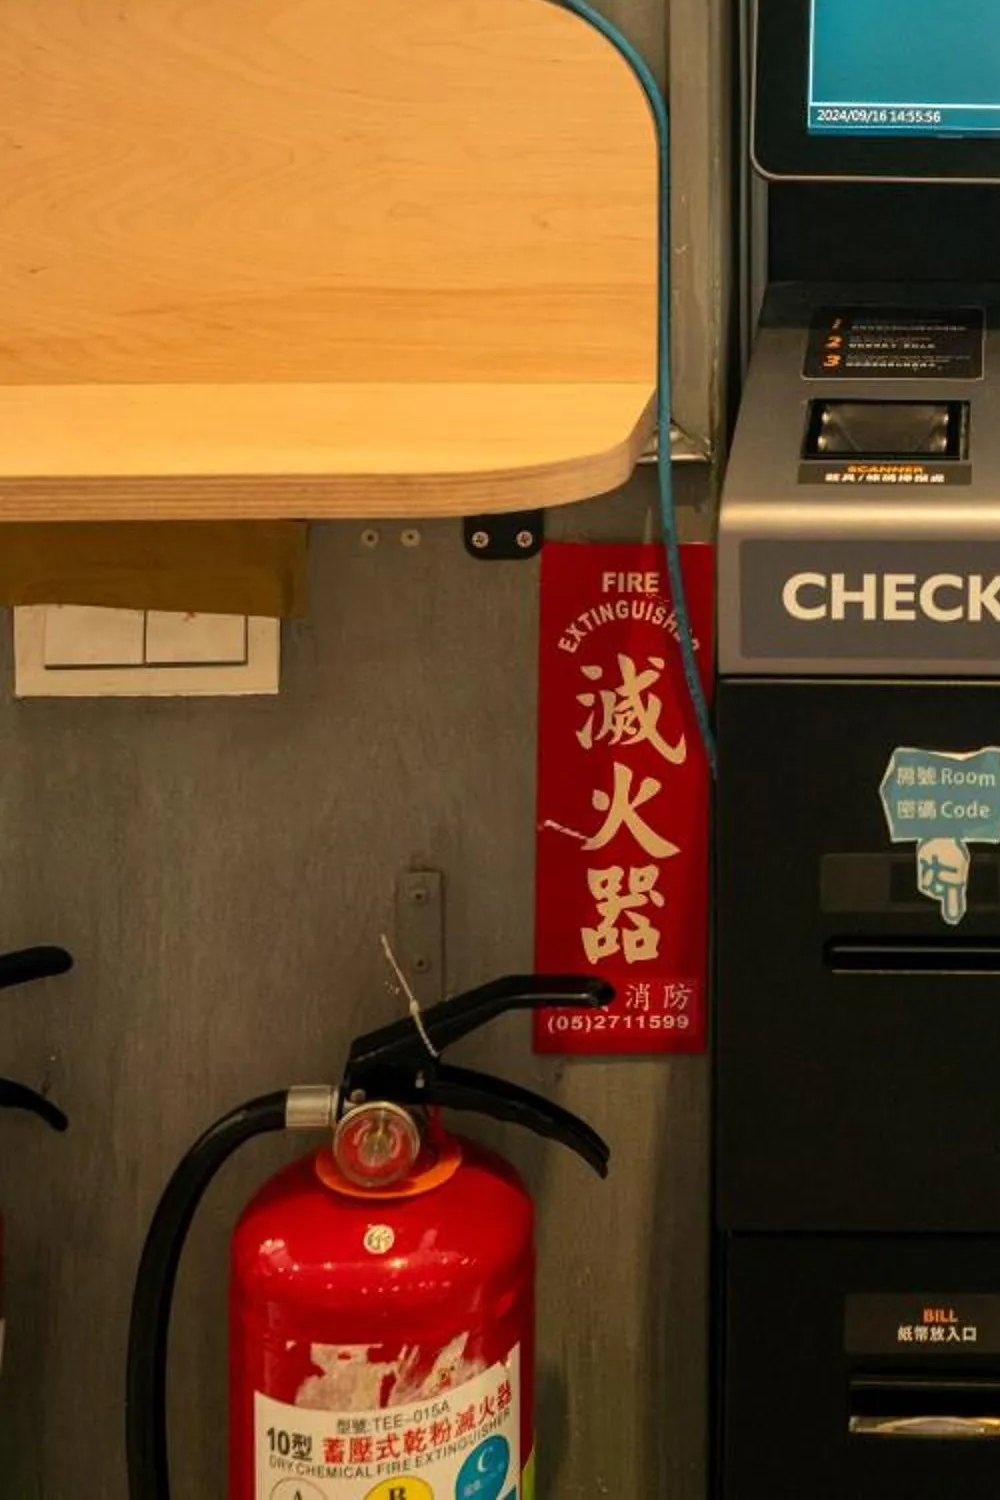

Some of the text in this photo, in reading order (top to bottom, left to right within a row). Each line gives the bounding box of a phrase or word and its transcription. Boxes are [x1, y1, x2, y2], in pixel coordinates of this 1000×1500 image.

[816, 108, 887, 123] 2024/09/16
[823, 354, 842, 368] 3
[602, 571, 660, 593] FIRE
[557, 599, 700, 653] EXTINGUISH
[940, 767, 996, 787] Room
[575, 653, 687, 965] 滅火器
[940, 800, 992, 819] Code
[547, 1014, 690, 1033] (05)2711599
[923, 1308, 959, 1324] BILL
[897, 1325, 977, 1342] 紙幣放入口
[266, 1427, 314, 1462] 10型
[293, 1463, 374, 1479] CHEMICAL
[376, 1459, 410, 1476] FIRE
